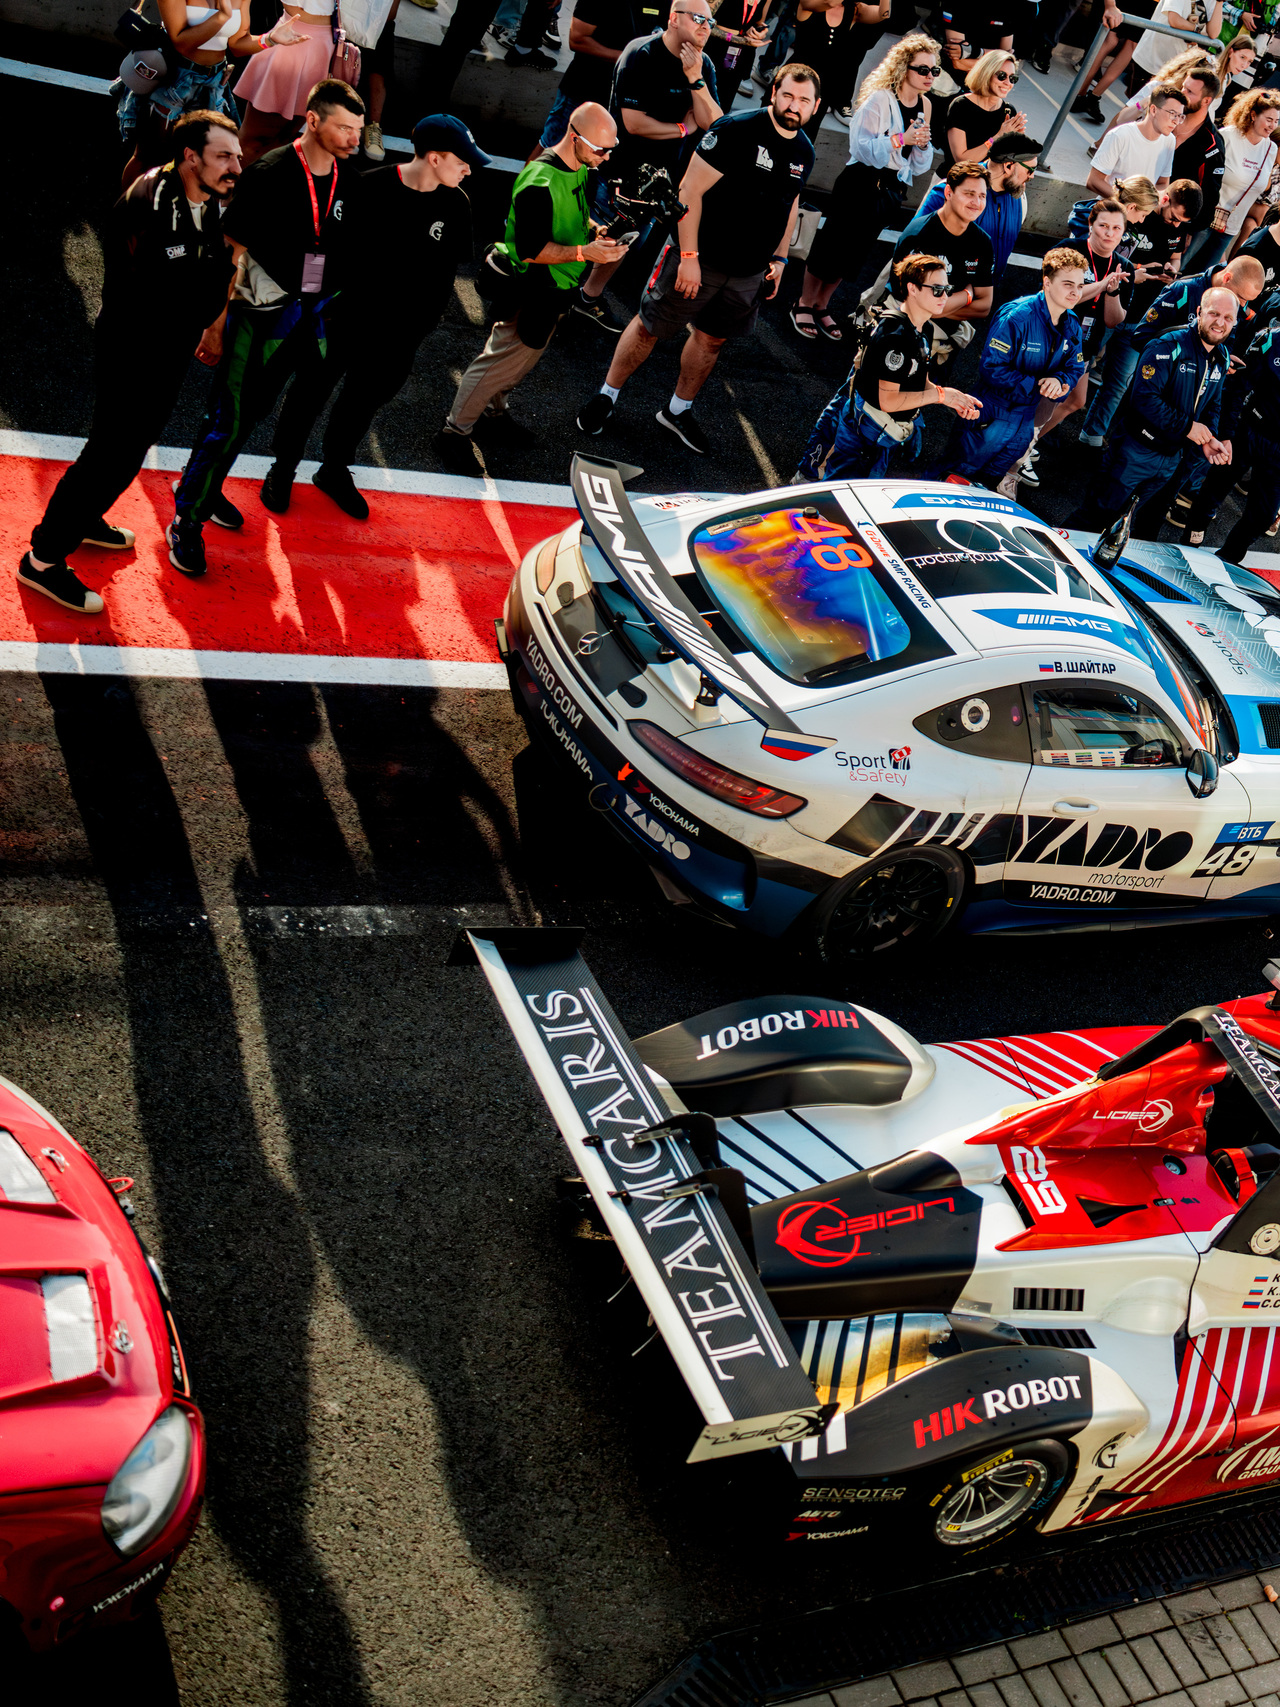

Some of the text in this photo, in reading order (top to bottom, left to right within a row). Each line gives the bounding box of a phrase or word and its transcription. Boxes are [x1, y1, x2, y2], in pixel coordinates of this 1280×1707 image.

[796, 516, 873, 572] 48
[913, 552, 1000, 569] motrsport
[887, 558, 907, 577] SMP
[901, 576, 932, 609] RACING
[1049, 615, 1113, 633] AMG
[1053, 661, 1117, 675] В.ШАЙТАР
[1211, 633, 1248, 677] Sport
[526, 635, 584, 729] YADRO.COM
[834, 751, 887, 770] Sport
[849, 768, 908, 787] &Safety
[624, 793, 691, 860] YADRO
[650, 793, 700, 837] YOKOHAMA
[1238, 827, 1264, 840] ВТБ
[1005, 815, 1194, 871] YADRO
[1197, 844, 1254, 877] 48
[1029, 885, 1117, 904] YADRO.COM
[1088, 873, 1166, 889] motorsport
[697, 1009, 860, 1061] HIKROBOT
[1093, 1108, 1161, 1121] LIGIER
[526, 990, 766, 1380] TEAMGARIS
[1010, 1146, 1067, 1216] 29
[815, 1197, 955, 1242] LIGIER
[913, 1375, 1081, 1449] HIKROBOT
[803, 1487, 906, 1498] SENSOTEC
[806, 1526, 869, 1540] YOKOHAMA
